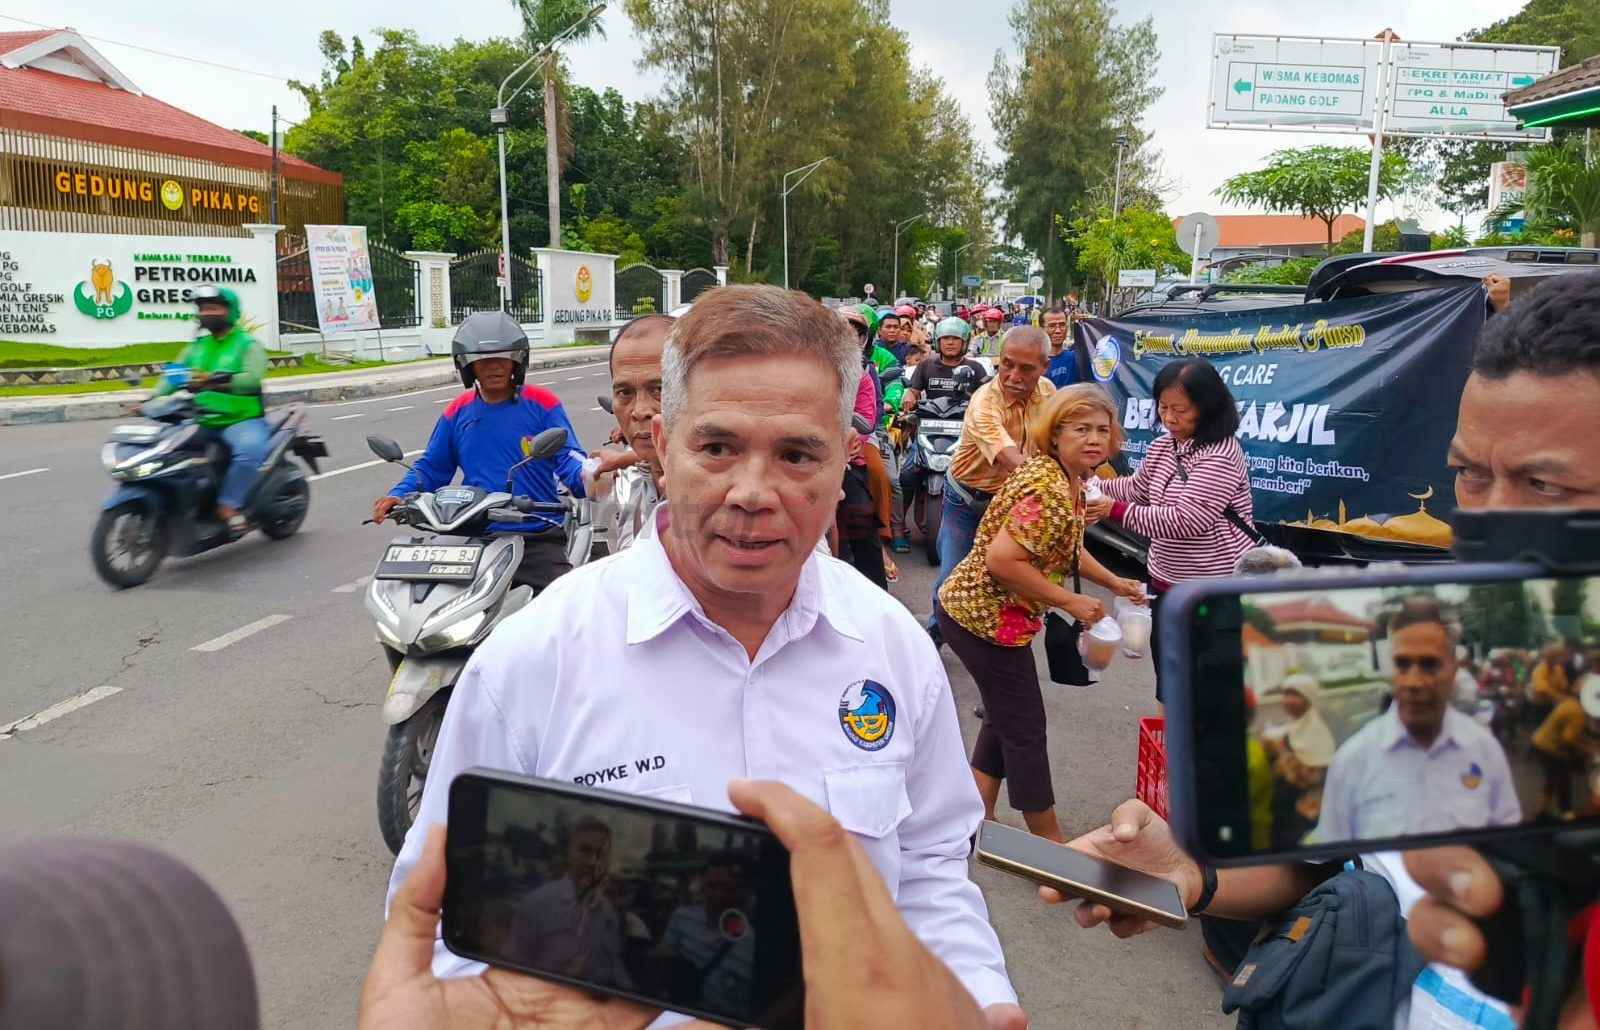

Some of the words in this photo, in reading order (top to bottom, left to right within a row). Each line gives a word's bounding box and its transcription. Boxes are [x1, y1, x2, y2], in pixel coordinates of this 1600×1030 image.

[1263, 71, 1300, 82] WSMA
[1304, 73, 1360, 84] KEBOMAS
[1260, 93, 1305, 105] PADANG
[1309, 95, 1339, 107] GOLF
[55, 172, 153, 201] GEDUNG
[191, 188, 233, 210] PIKA
[237, 195, 259, 213] PG
[0, 252, 11, 261] G
[134, 254, 182, 262] KAWASAN
[2, 262, 19, 271] PG
[134, 266, 256, 282] PETROKIMIA
[0, 283, 32, 293] GOLF
[23, 294, 64, 304] GRESIK
[136, 288, 194, 303] GRES
[16, 304, 49, 313] TENIS
[97, 307, 115, 318] PG
[554, 309, 585, 323] GEDUNG
[1234, 364, 1278, 385] CARE
[1278, 456, 1304, 473] kita
[1306, 458, 1369, 481] berikan,
[411, 550, 447, 561] 6157
[458, 550, 477, 562] BJ
[634, 755, 666, 774] W.D
